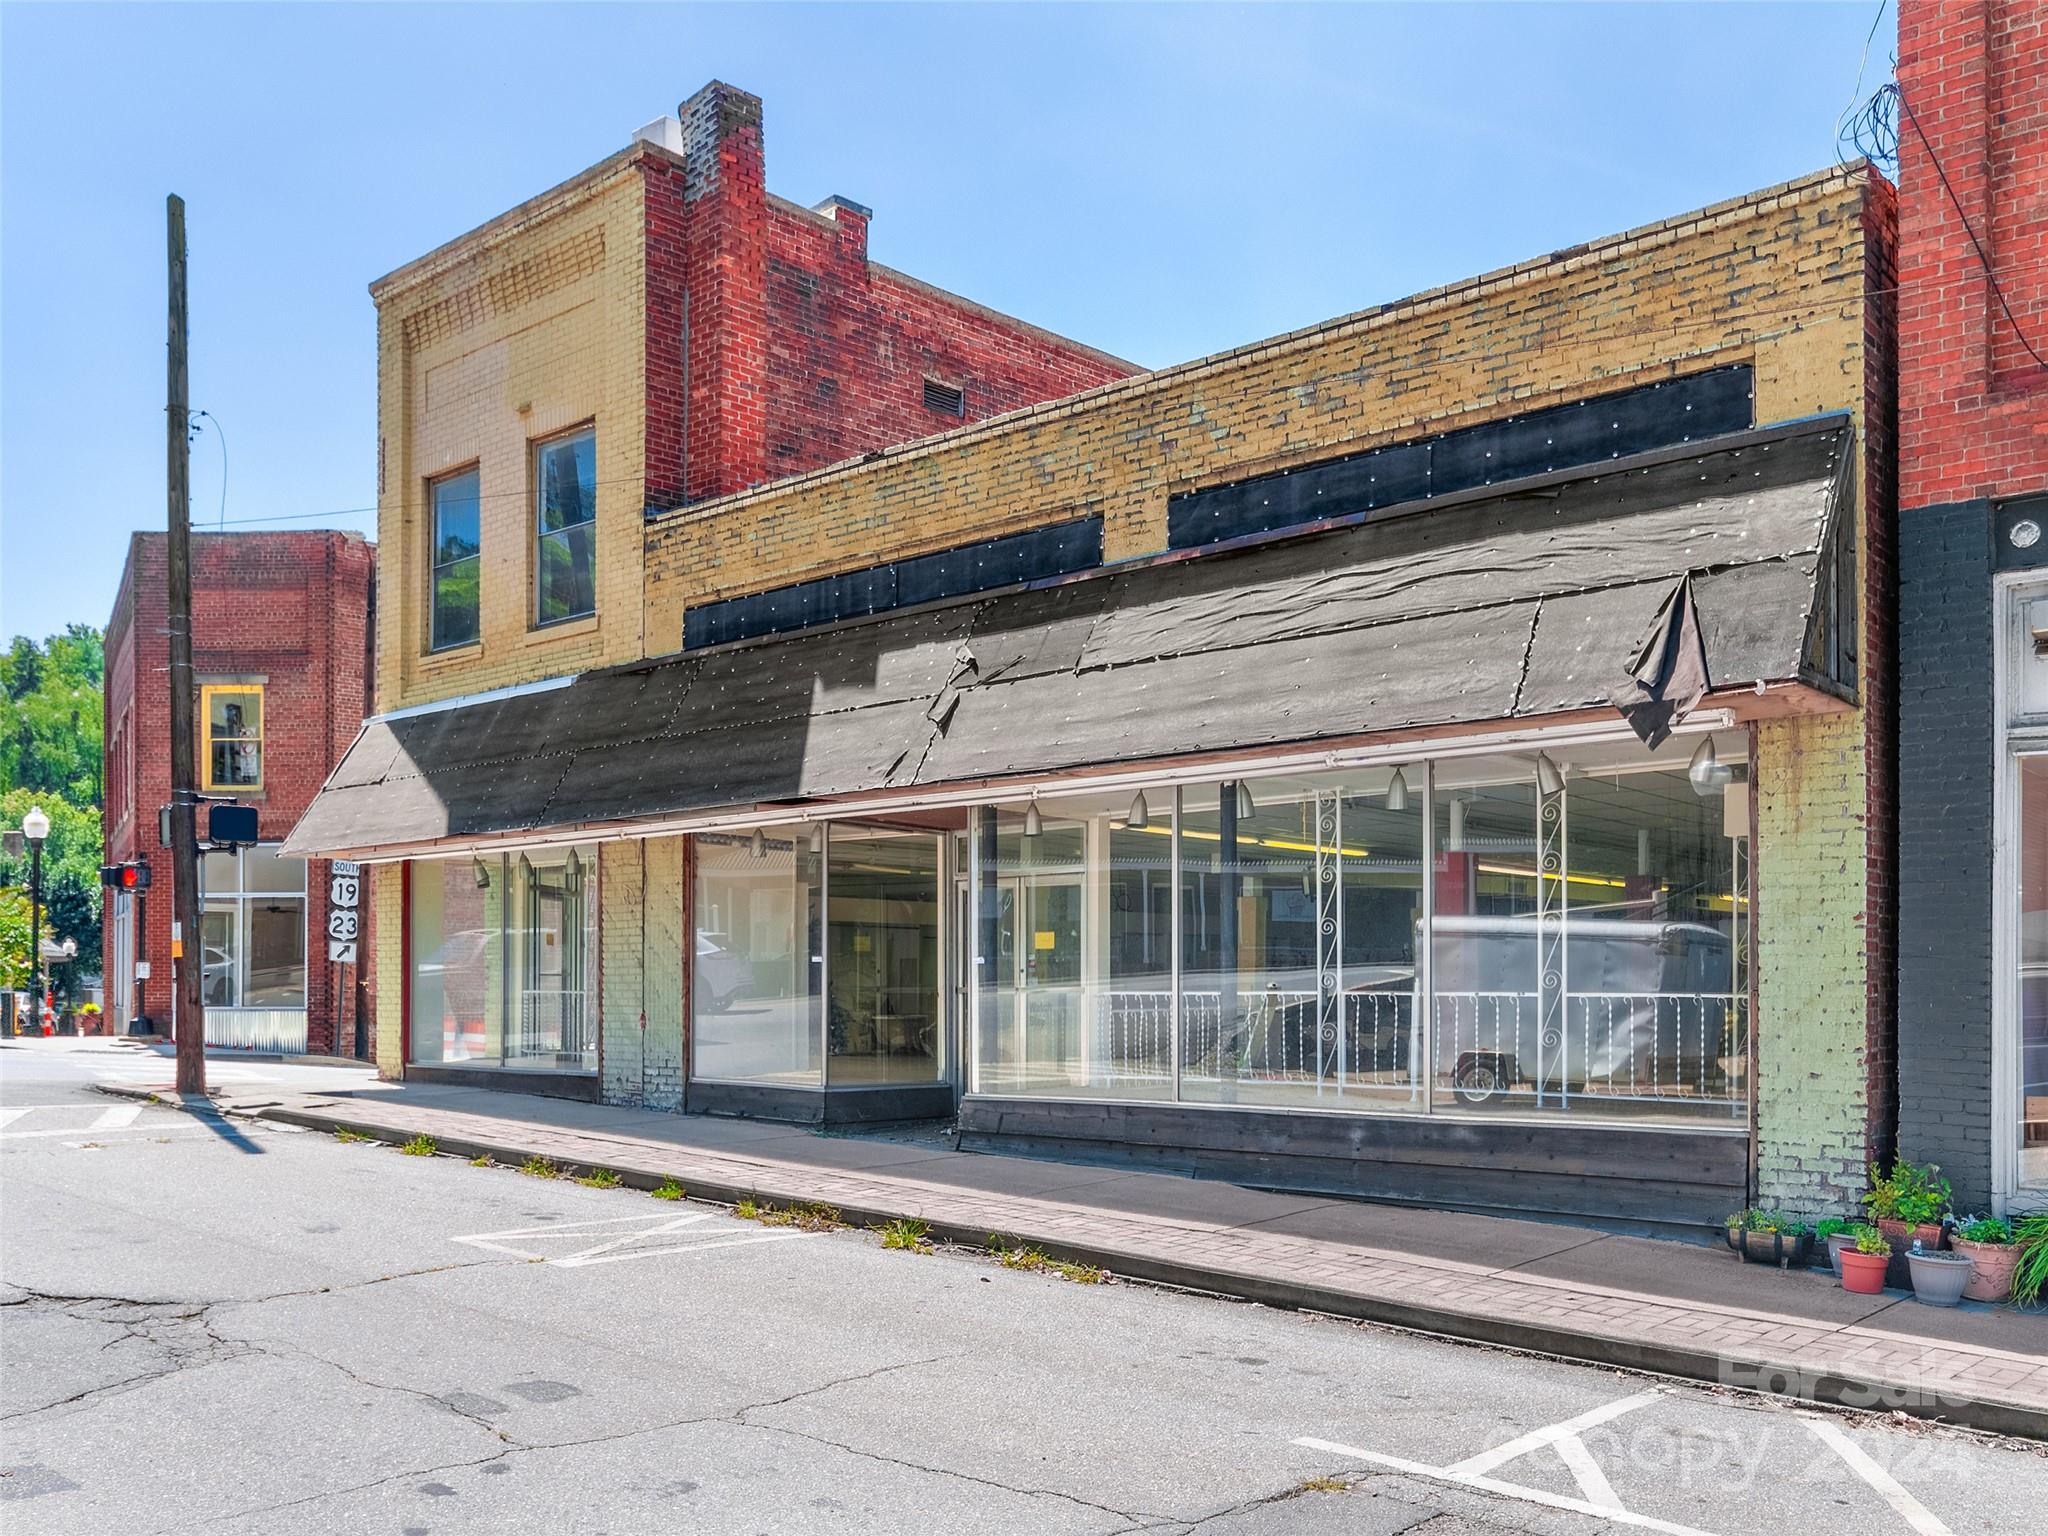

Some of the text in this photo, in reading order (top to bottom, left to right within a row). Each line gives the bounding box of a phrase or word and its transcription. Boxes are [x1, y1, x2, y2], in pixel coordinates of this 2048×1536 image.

[334, 861, 360, 872] SOUTH
[338, 882, 357, 901] 19
[332, 915, 357, 935] 23
